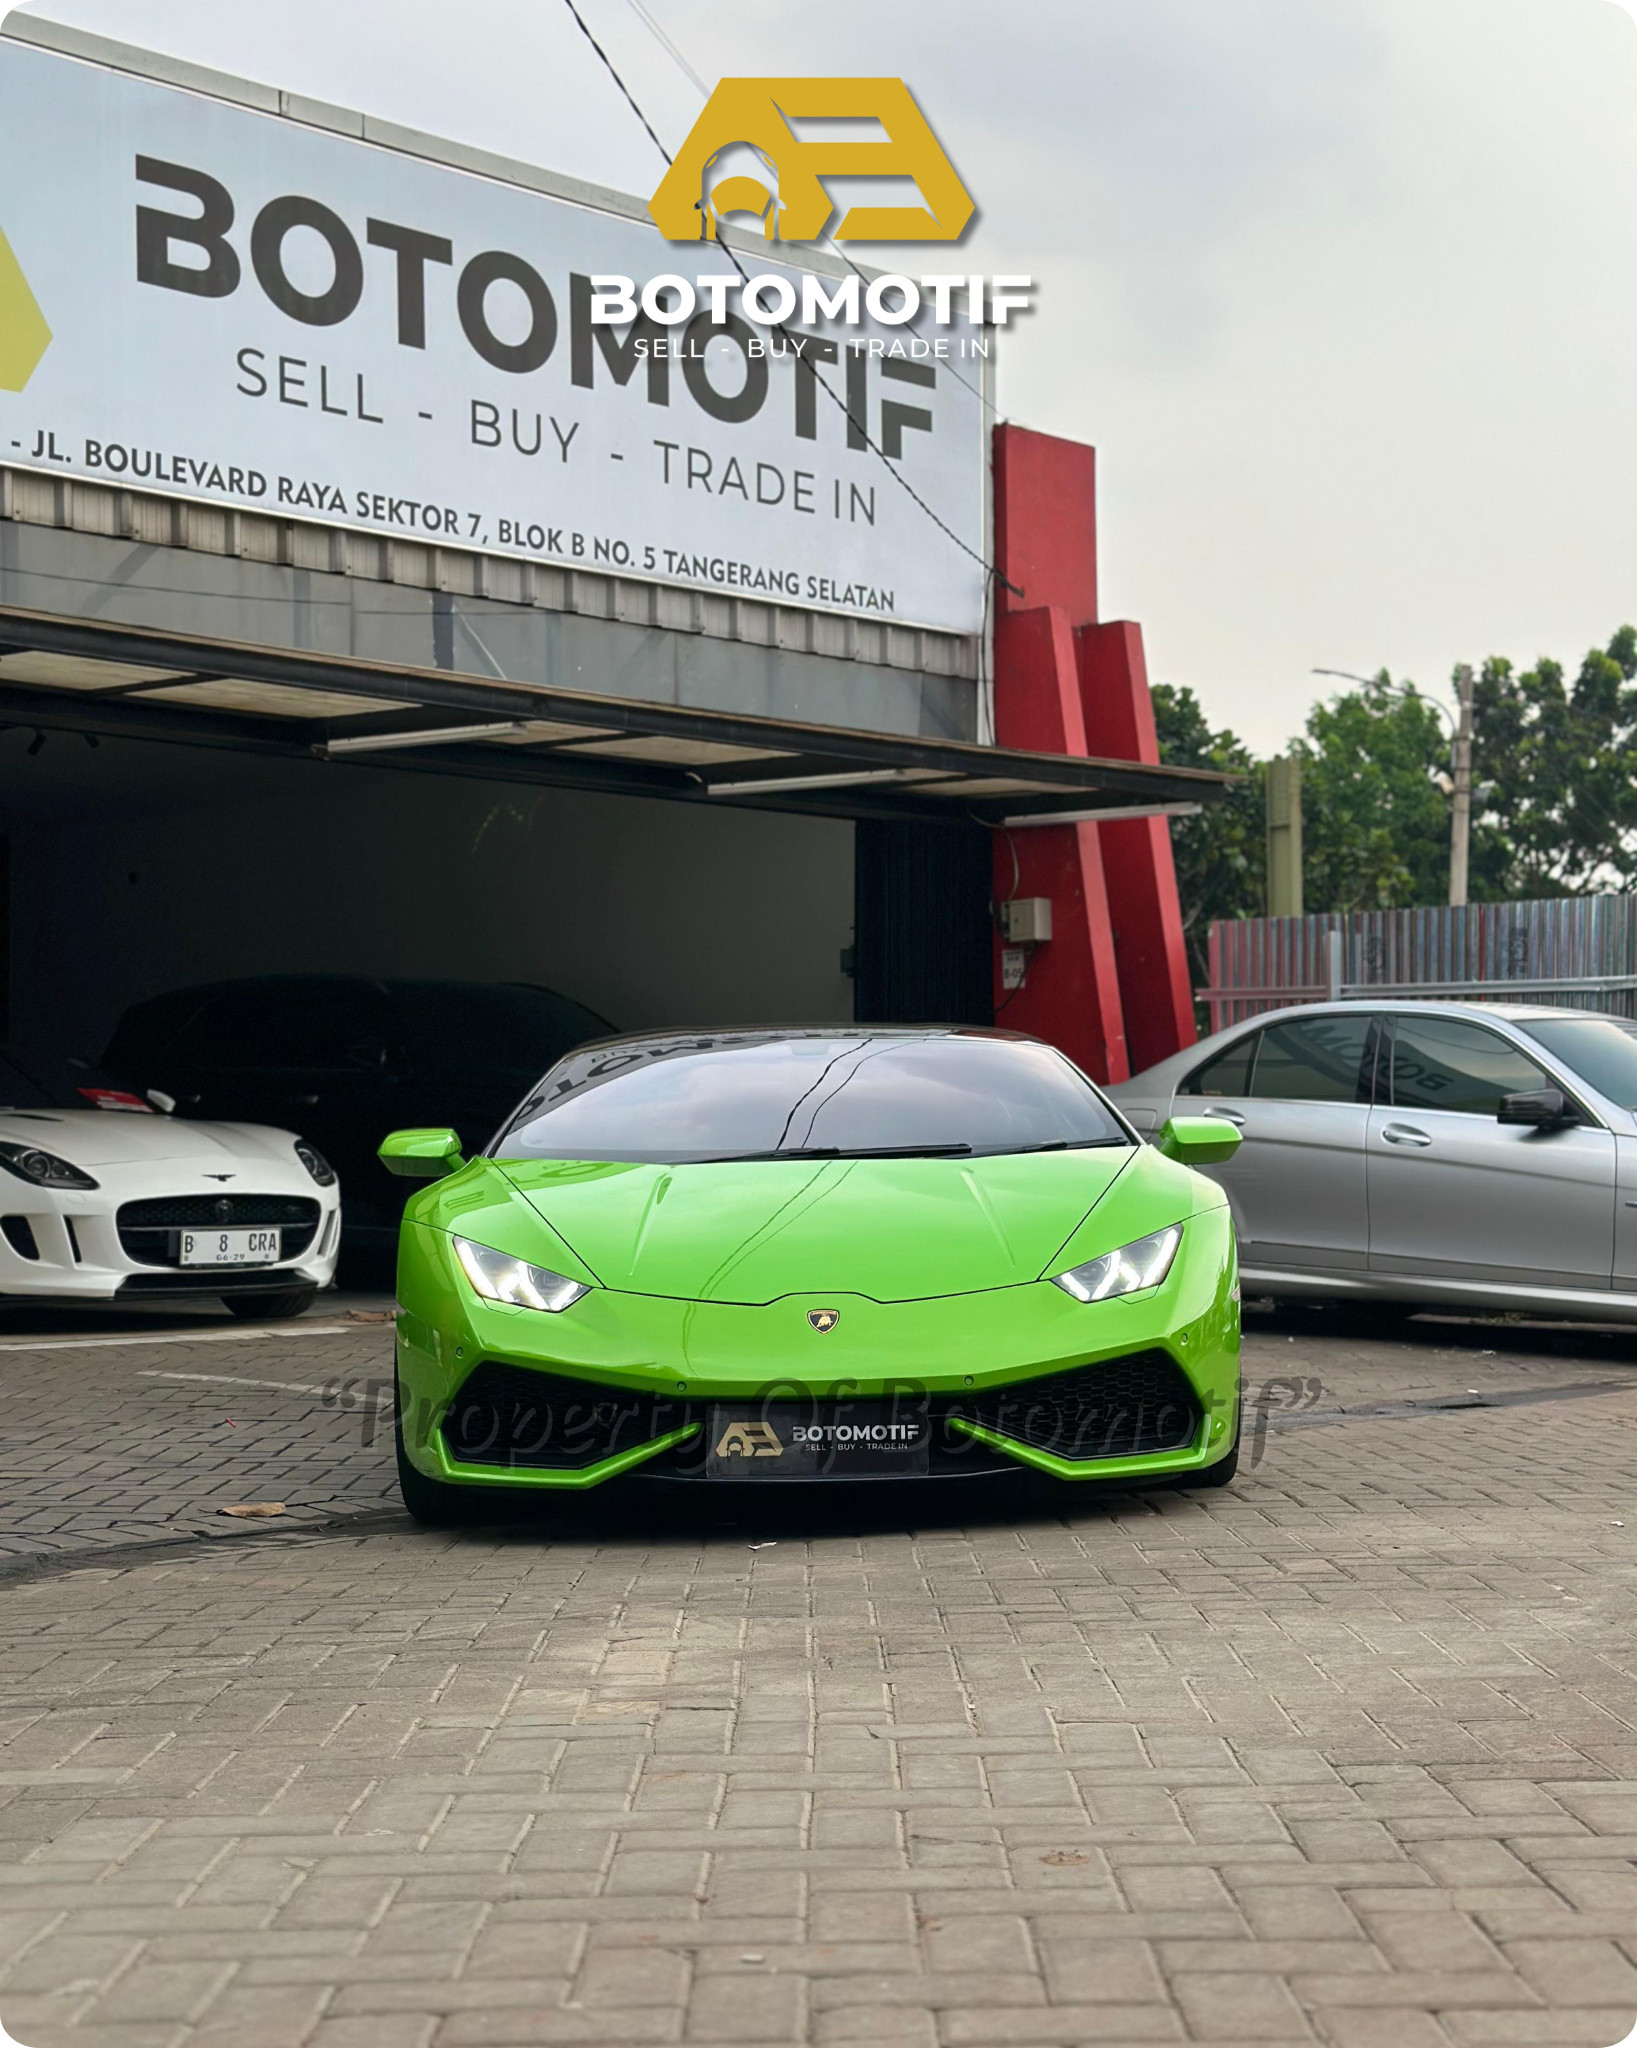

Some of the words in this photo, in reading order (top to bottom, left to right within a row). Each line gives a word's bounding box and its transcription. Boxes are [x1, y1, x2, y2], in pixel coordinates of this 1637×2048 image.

[135, 153, 937, 460] BOTOMOTIF
[236, 347, 384, 424] SELL
[471, 399, 579, 464] BUY
[653, 440, 815, 514] TRADE
[834, 479, 876, 526] IN
[31, 429, 71, 463] JL.
[85, 439, 267, 497] BOULEVARD
[278, 476, 348, 514] RAYA
[356, 491, 459, 534] SEKTOR
[467, 513, 489, 545] 7,
[499, 519, 563, 554] BLOK
[572, 532, 585, 557] B
[594, 537, 635, 567] NO.
[643, 547, 656, 570] 5
[663, 549, 800, 596] TANGERANG
[807, 575, 895, 612] SELATAN
[185, 1235, 194, 1254] B
[219, 1233, 229, 1253] 8
[248, 1232, 277, 1252] CRA
[792, 1424, 920, 1442] BOTOMOTIF
[805, 1443, 827, 1451] SELL
[837, 1443, 856, 1451] BUY
[866, 1442, 896, 1451] TRADE
